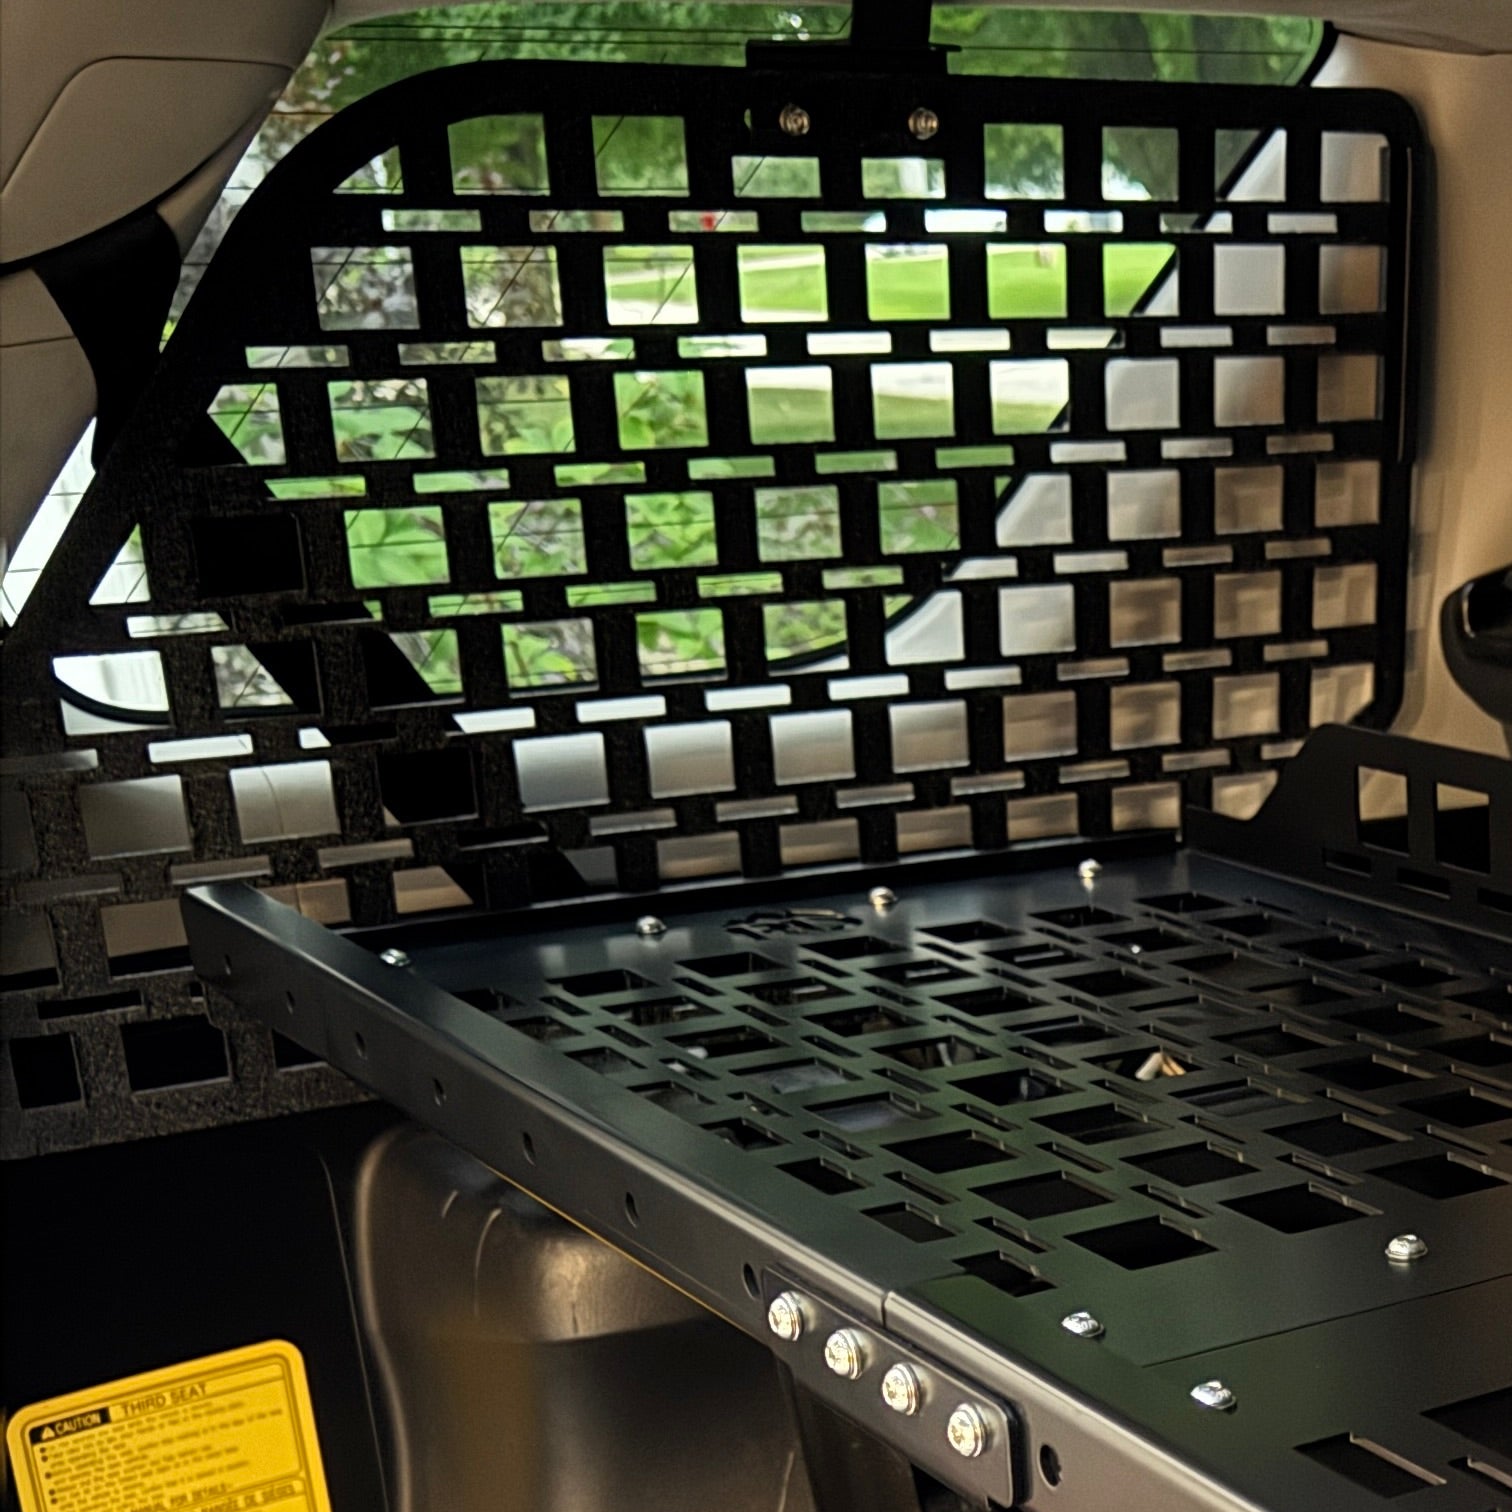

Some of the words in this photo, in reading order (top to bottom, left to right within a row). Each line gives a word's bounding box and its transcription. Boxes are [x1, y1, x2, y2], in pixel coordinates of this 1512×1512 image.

[121, 1393, 166, 1416] THIRD
[170, 1382, 208, 1405] SEAT
[55, 1412, 101, 1435] CAUTION
